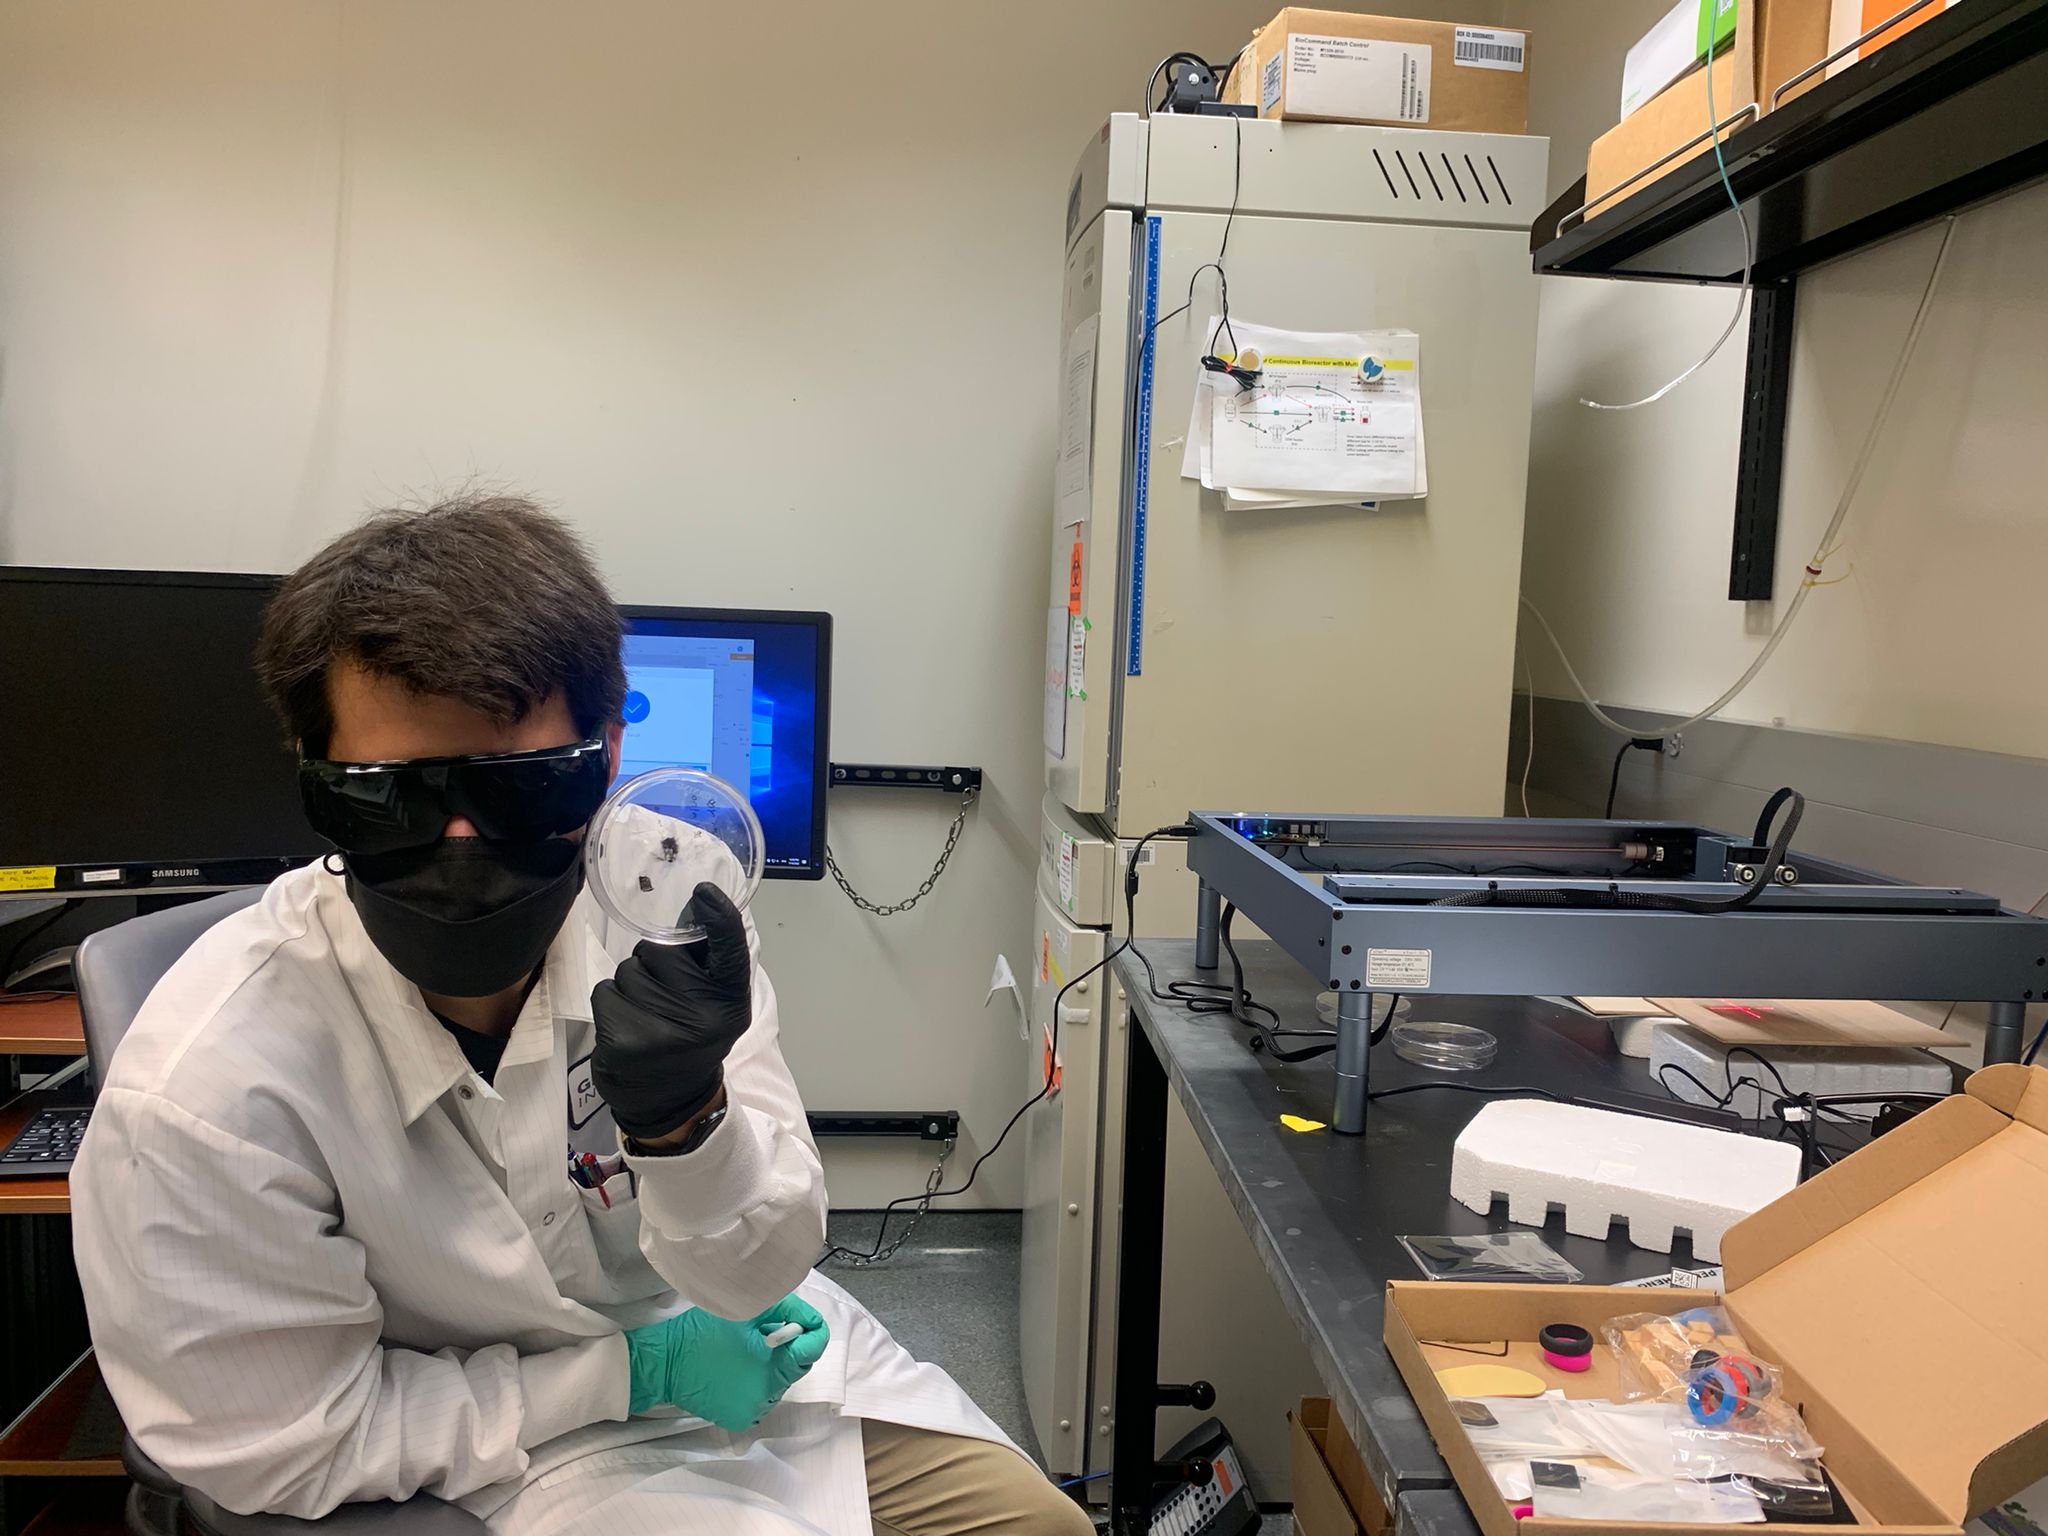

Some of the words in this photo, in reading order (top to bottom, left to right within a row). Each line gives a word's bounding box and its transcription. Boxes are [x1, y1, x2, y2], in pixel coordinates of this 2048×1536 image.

[1295, 37, 1332, 46] BioCommand
[1349, 41, 1370, 49] Control
[1302, 359, 1331, 367] Bioreactor
[151, 868, 200, 878] SAMSUNG
